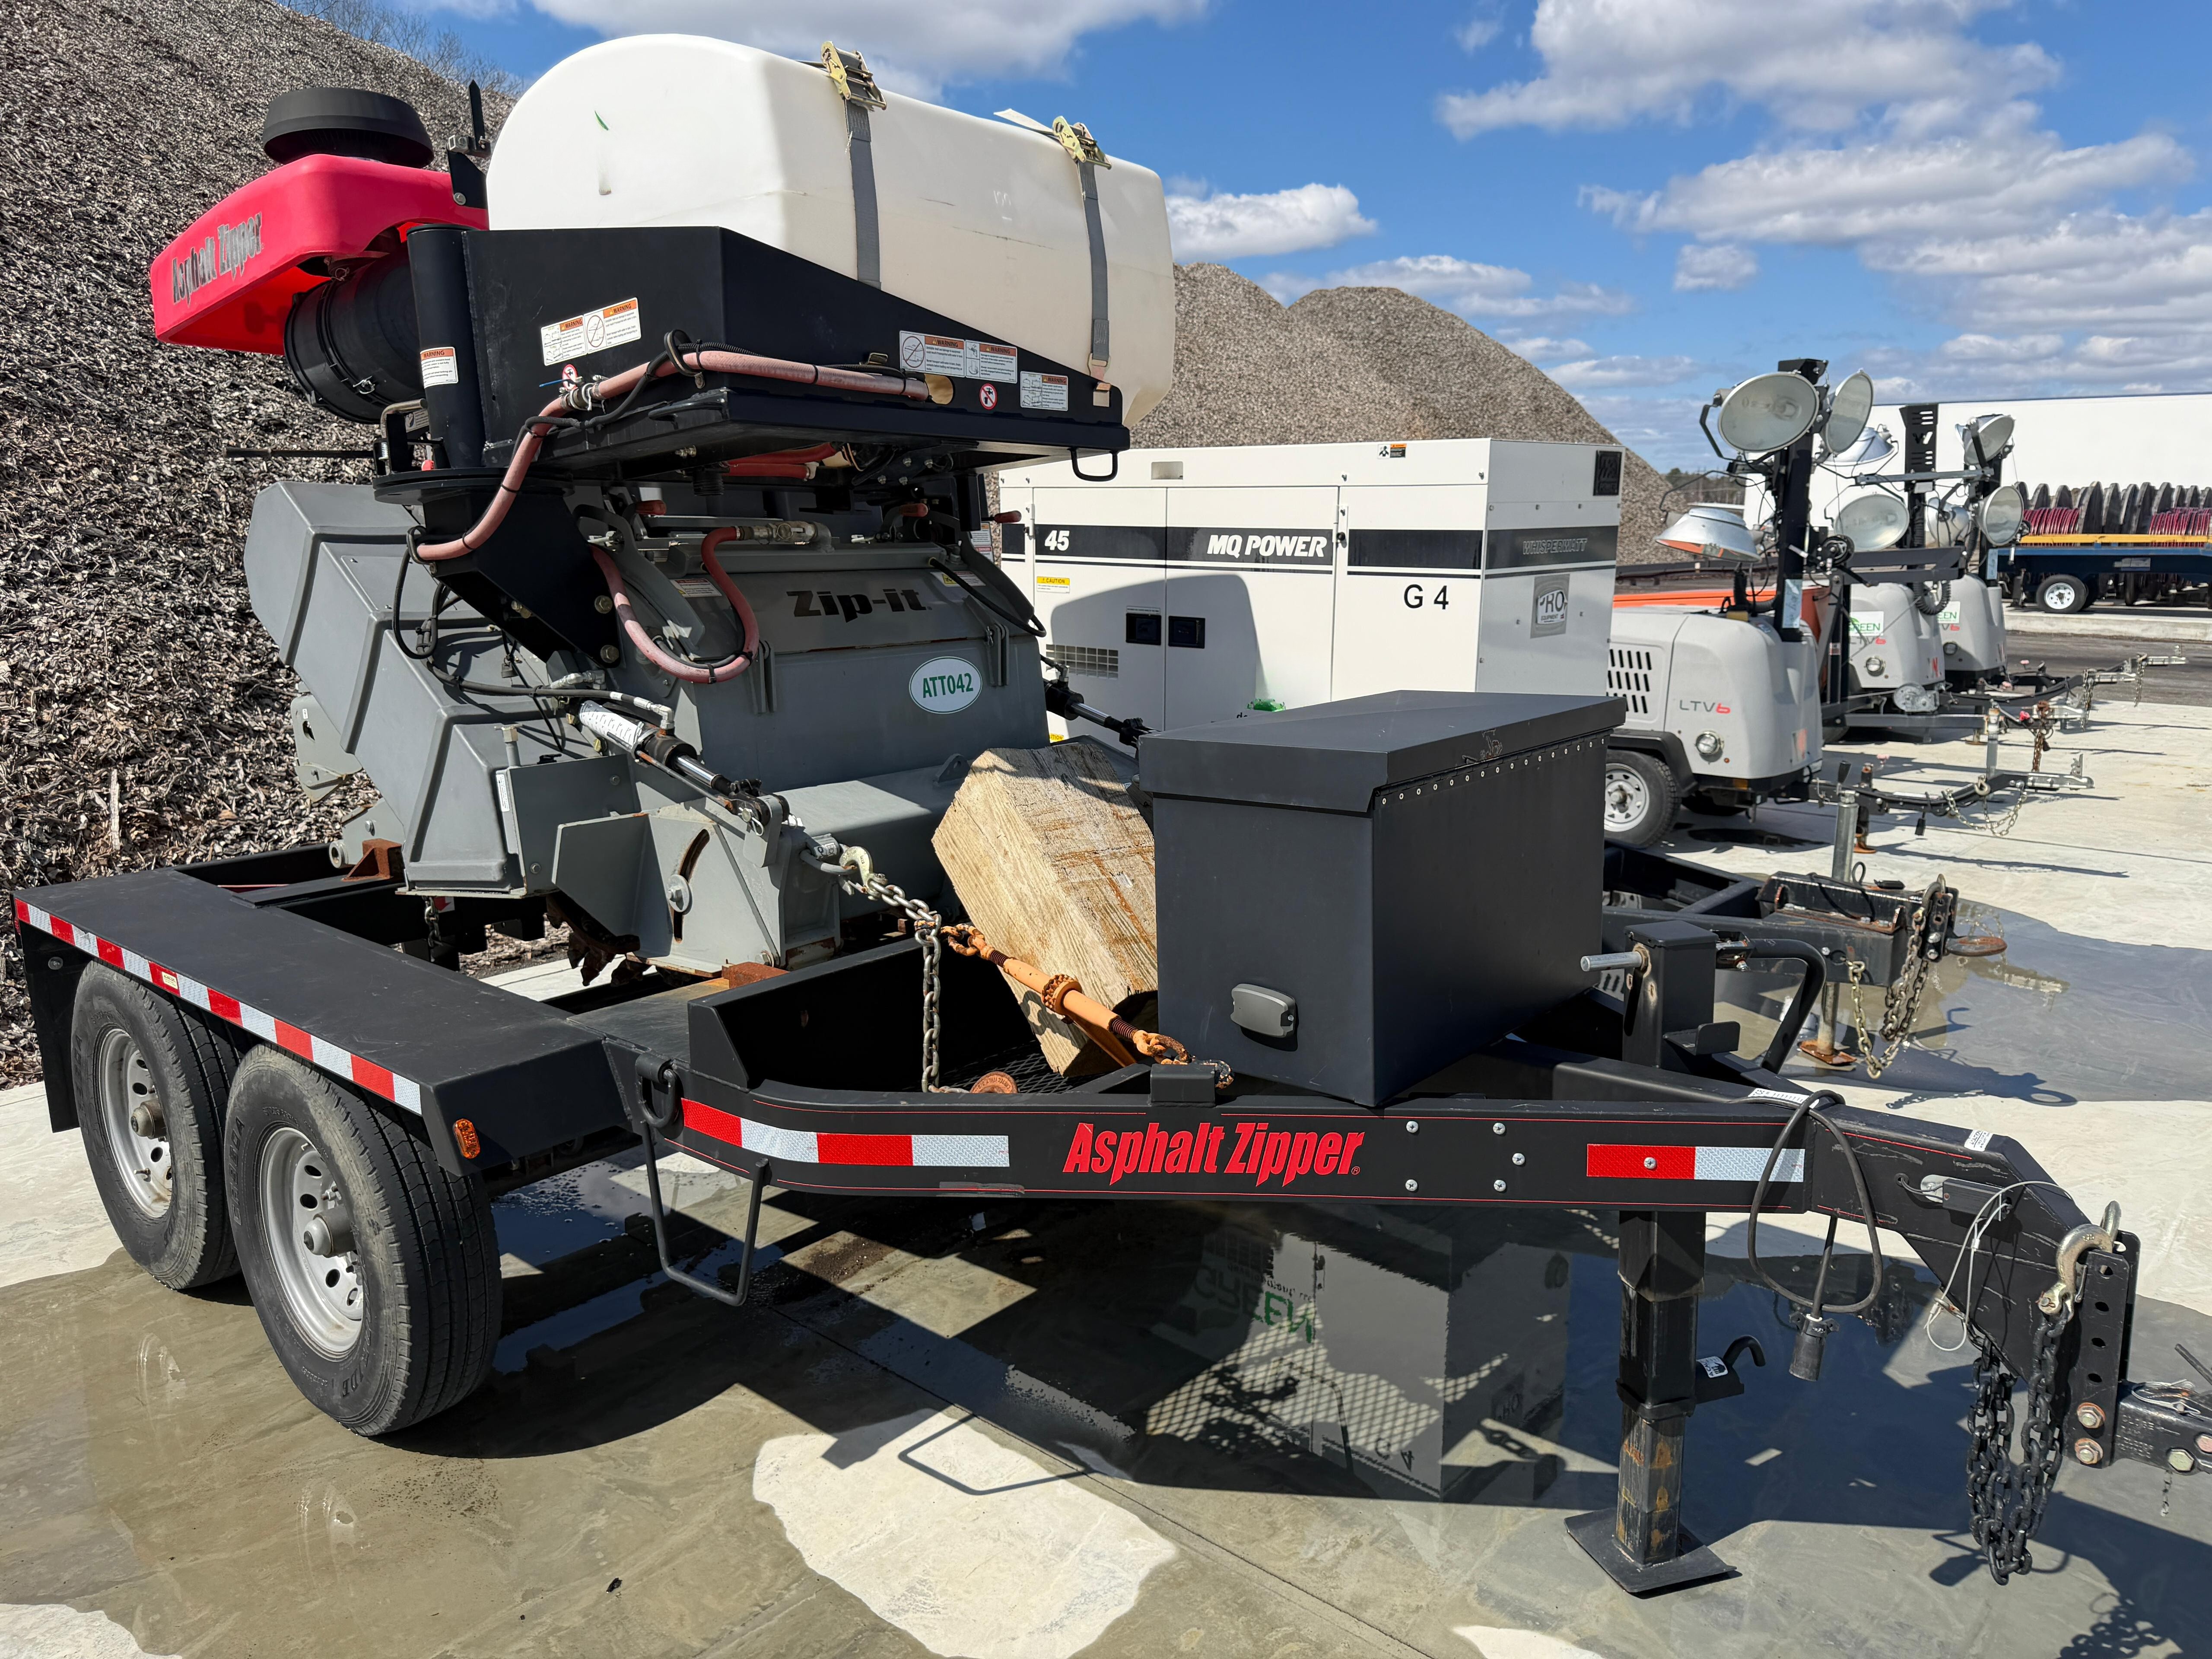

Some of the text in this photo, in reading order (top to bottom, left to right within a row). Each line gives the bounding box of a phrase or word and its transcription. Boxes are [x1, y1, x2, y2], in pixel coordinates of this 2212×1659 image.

[173, 237, 217, 308] Asphalt
[613, 303, 631, 314] WARNING
[565, 319, 582, 329] WARNING
[937, 339, 958, 347] WARNING
[1044, 531, 1070, 551] 45
[1207, 534, 1328, 558] MQ POWER
[1523, 538, 1588, 555] WHISPERWATT
[1403, 584, 1449, 610] G 4
[922, 672, 974, 699] ATT042
[1679, 700, 1731, 715] LTV6
[1062, 1122, 1224, 1186] Asphalt
